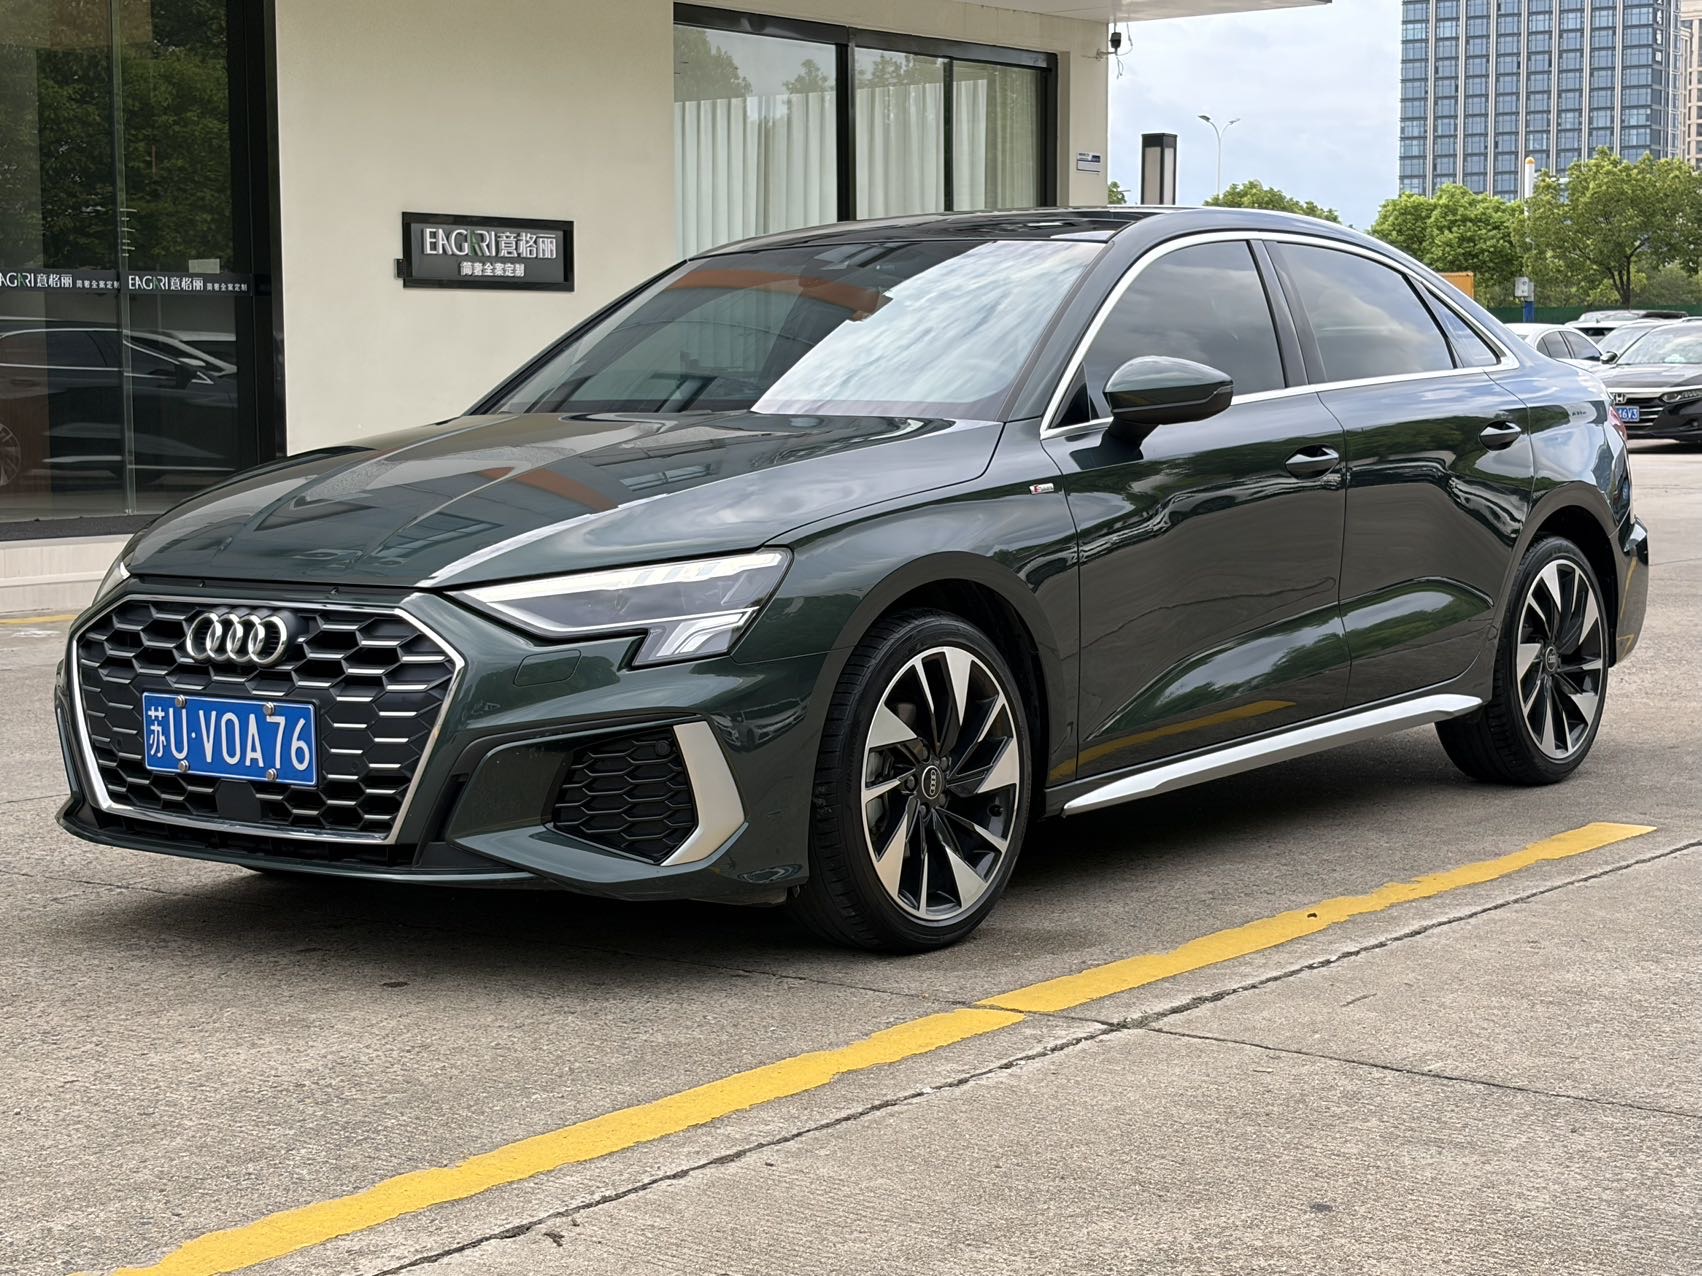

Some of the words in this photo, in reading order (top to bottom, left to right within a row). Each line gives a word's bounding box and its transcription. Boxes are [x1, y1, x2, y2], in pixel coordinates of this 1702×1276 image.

[497, 231, 556, 259] 意格丽
[460, 261, 525, 277] 简奢全案定制
[36, 273, 73, 288] 意格丽
[170, 276, 204, 291] 意格丽
